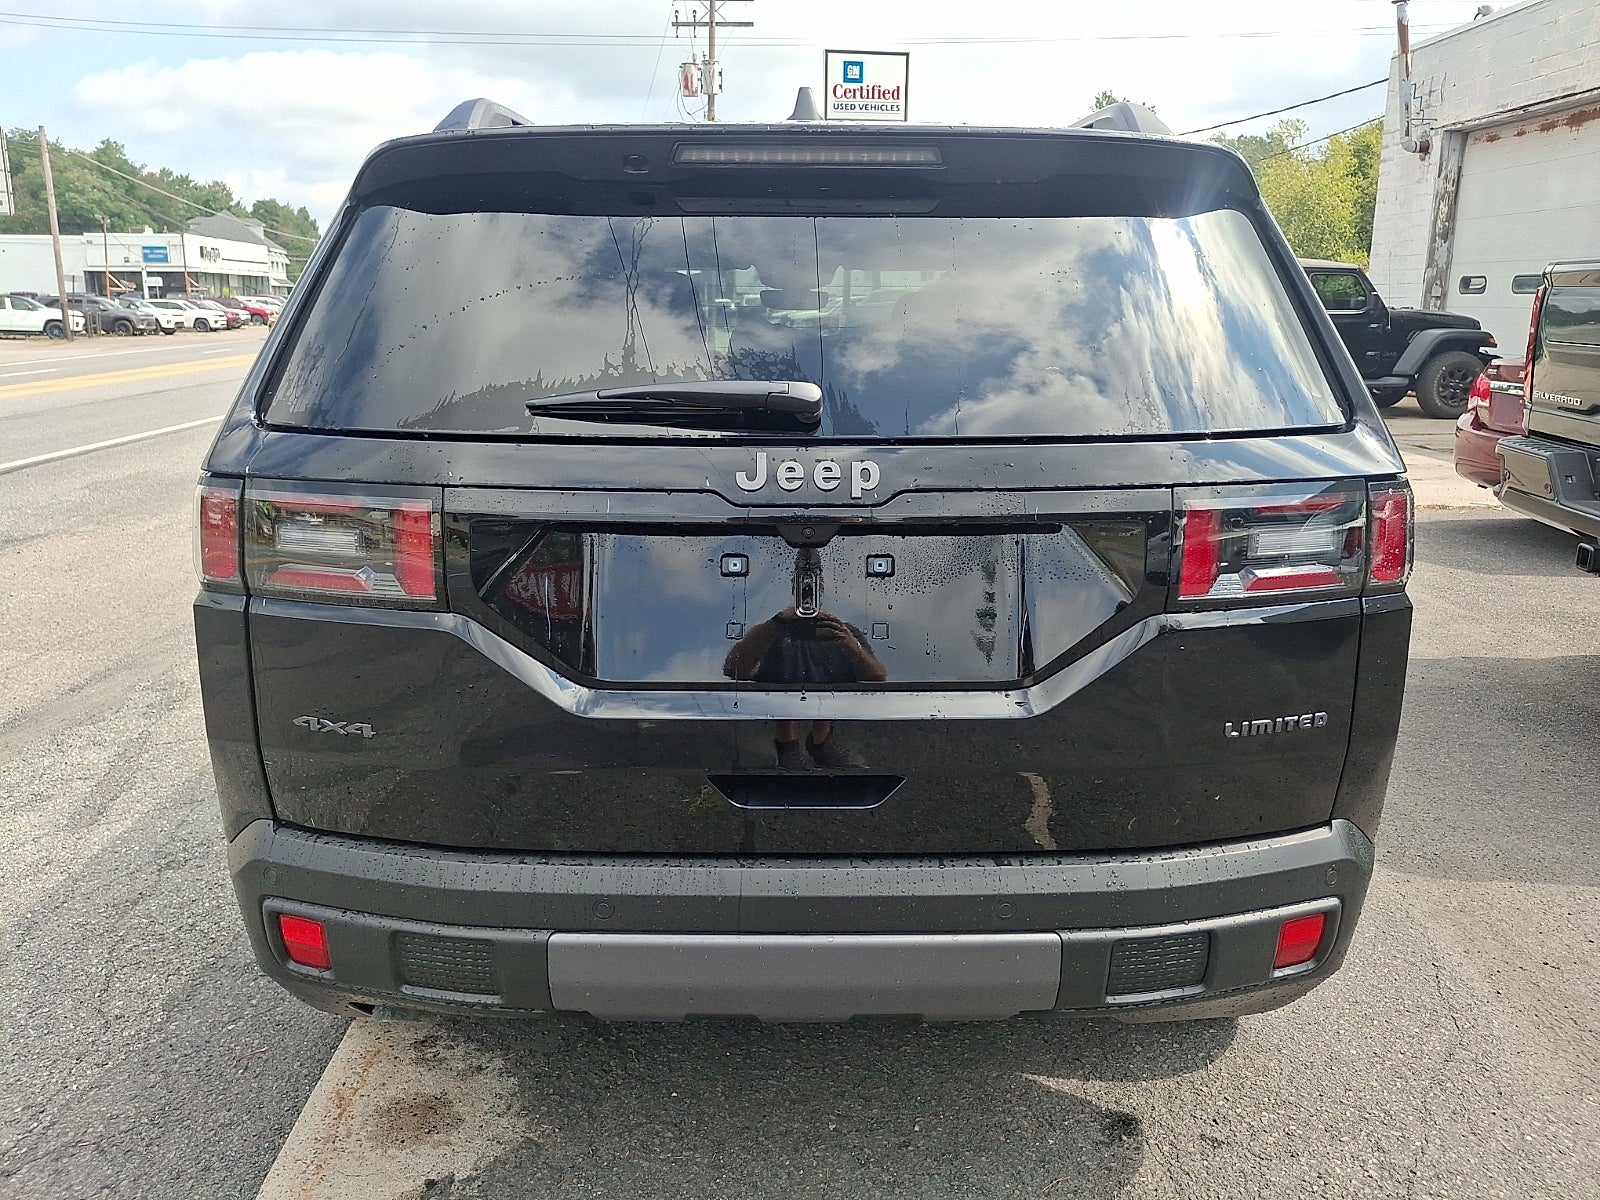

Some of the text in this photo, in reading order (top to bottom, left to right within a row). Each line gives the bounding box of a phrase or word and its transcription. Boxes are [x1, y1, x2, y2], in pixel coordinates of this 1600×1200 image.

[833, 84, 900, 100] Certified
[833, 103, 900, 112] USED VEHICLES
[1534, 391, 1582, 406] SILVERADO
[735, 452, 880, 499] Jeep
[1224, 711, 1328, 737] LIMITED
